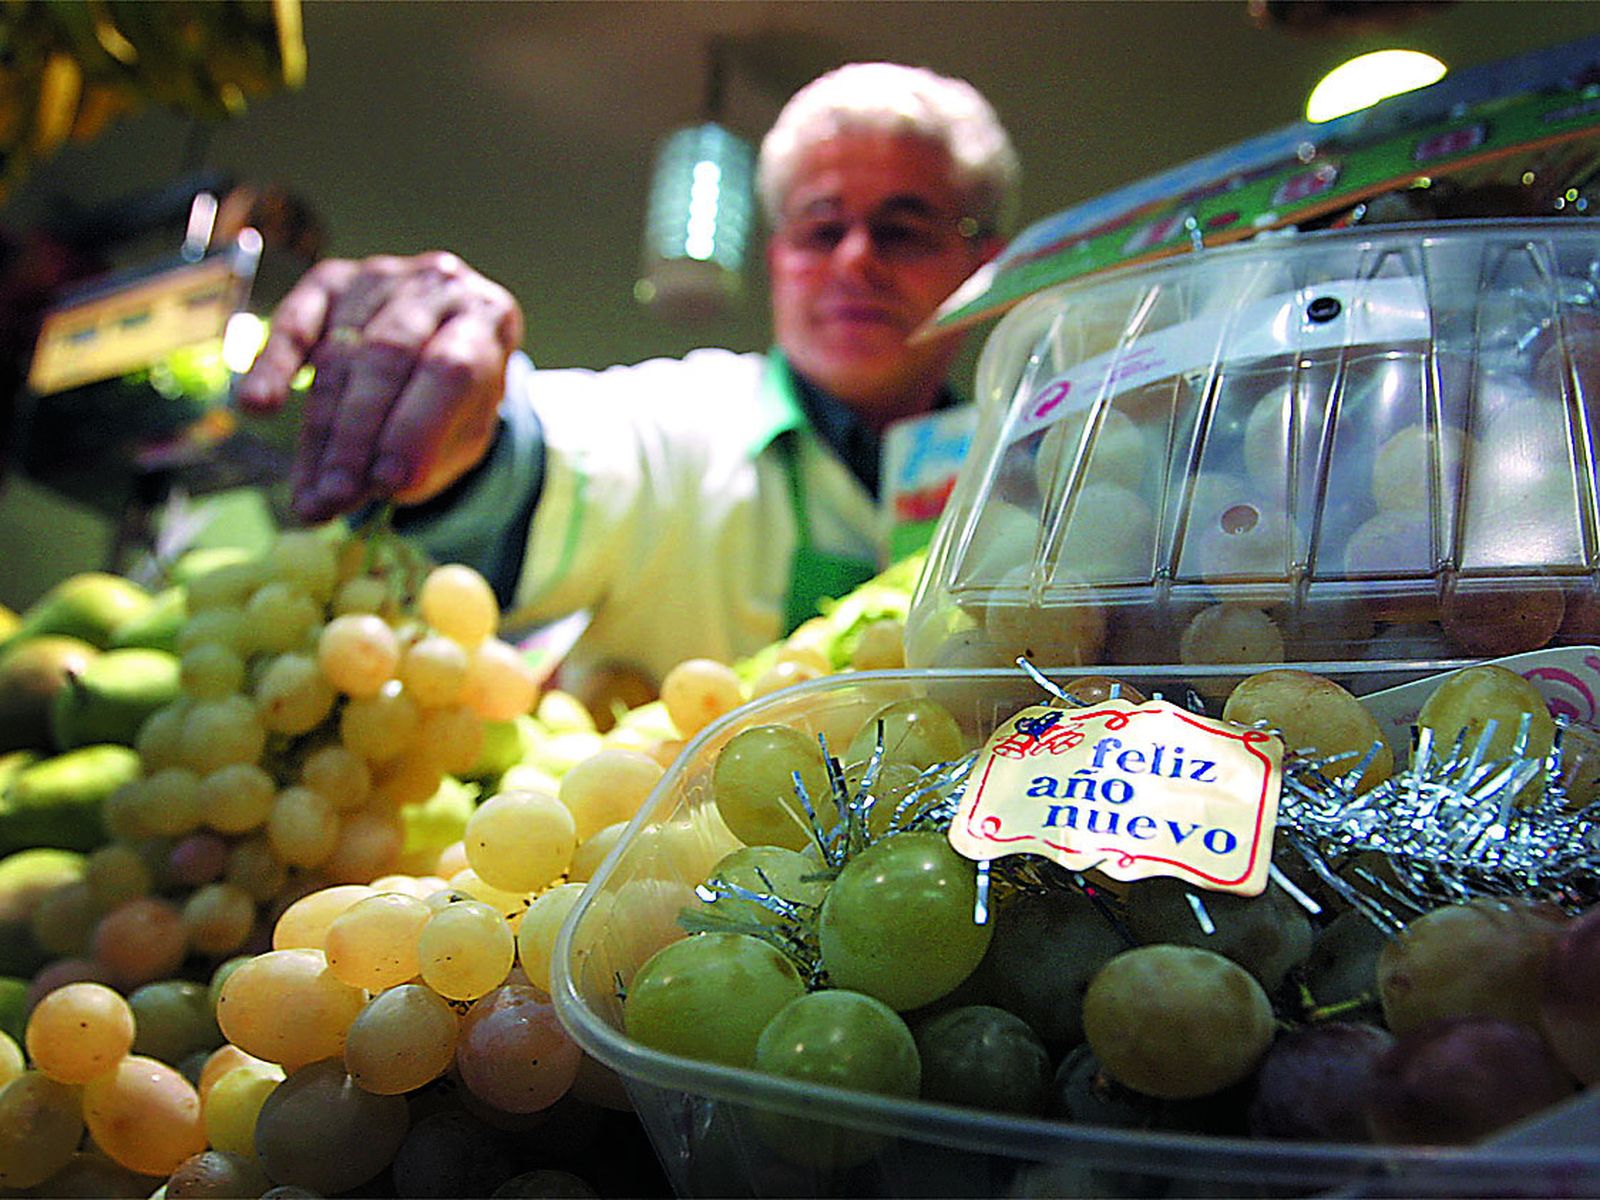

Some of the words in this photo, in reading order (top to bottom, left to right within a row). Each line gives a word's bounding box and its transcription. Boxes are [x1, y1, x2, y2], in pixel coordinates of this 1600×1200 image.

[1090, 737, 1218, 783] feliz
[1026, 769, 1135, 804] año
[1042, 803, 1238, 856] nuevo
